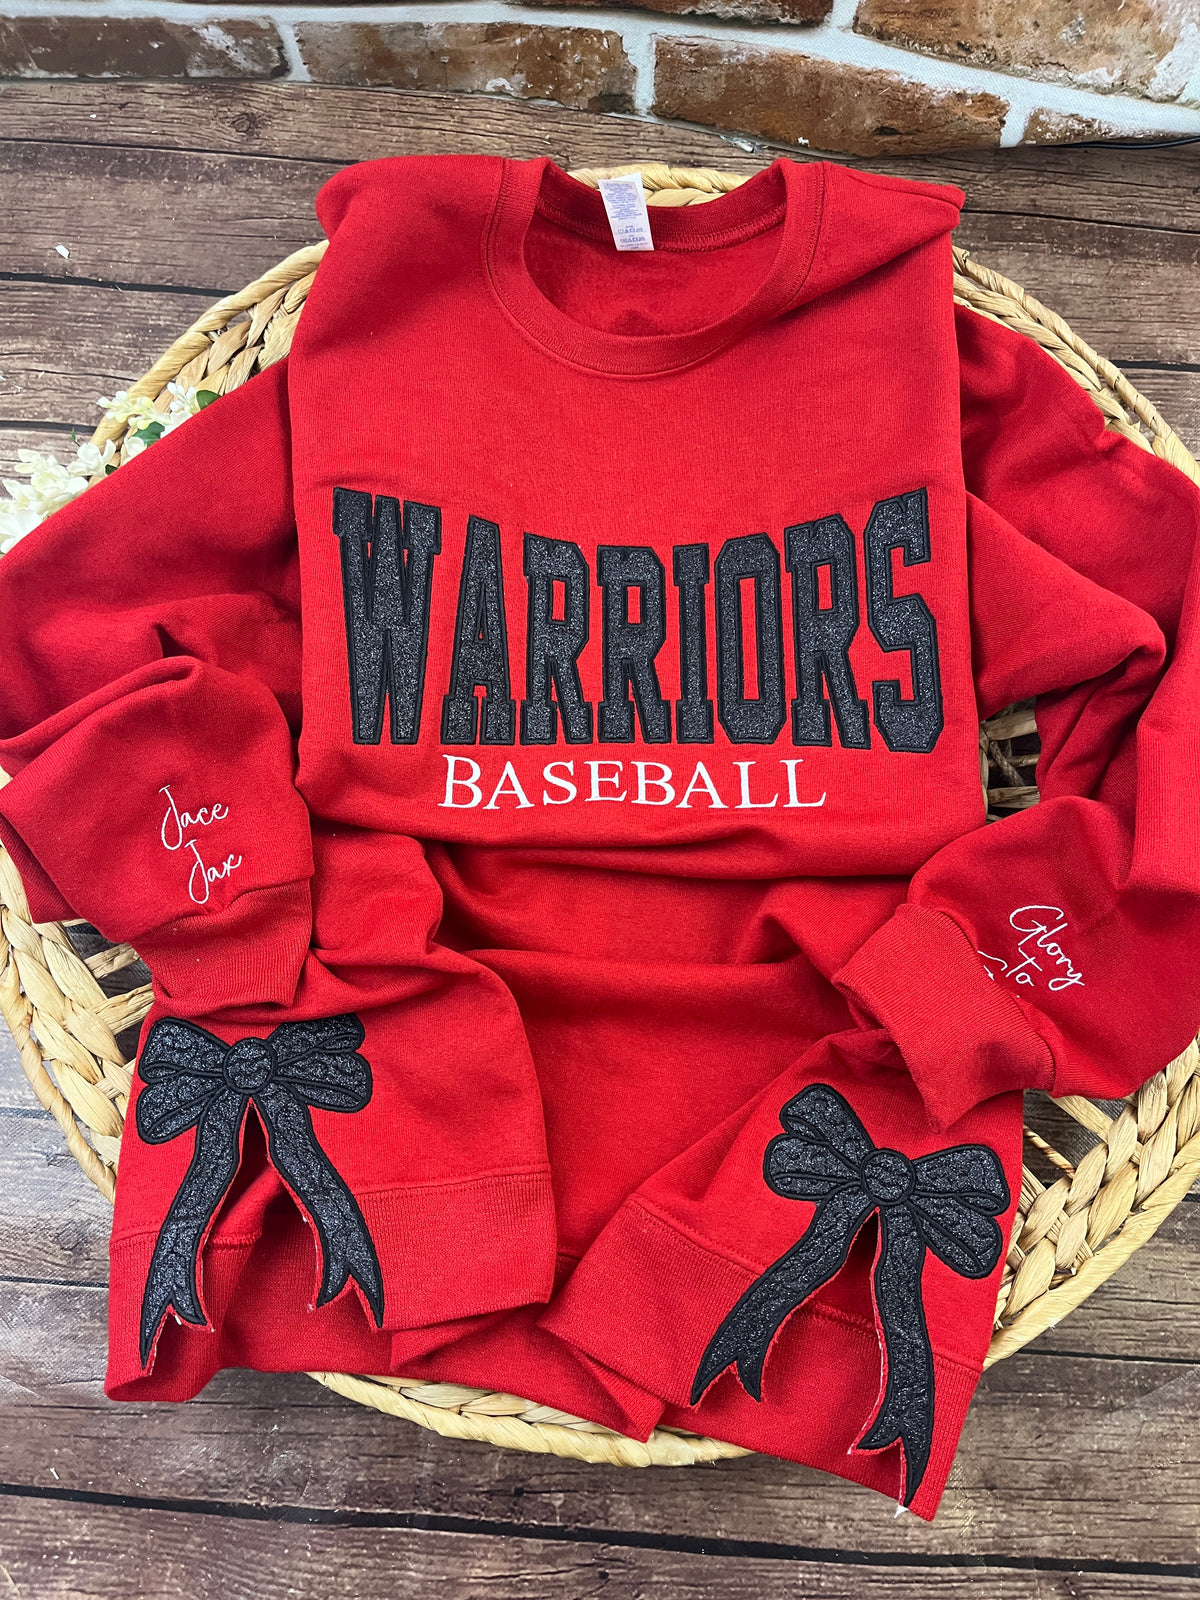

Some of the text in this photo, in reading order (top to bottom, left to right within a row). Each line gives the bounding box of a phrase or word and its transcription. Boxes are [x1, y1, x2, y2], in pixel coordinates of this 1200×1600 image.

[332, 486, 944, 753] WARRIORS
[438, 754, 826, 809] BASEBALL
[158, 785, 229, 851] Jace
[184, 839, 242, 904] Jax
[1009, 905, 1085, 991] Glory
